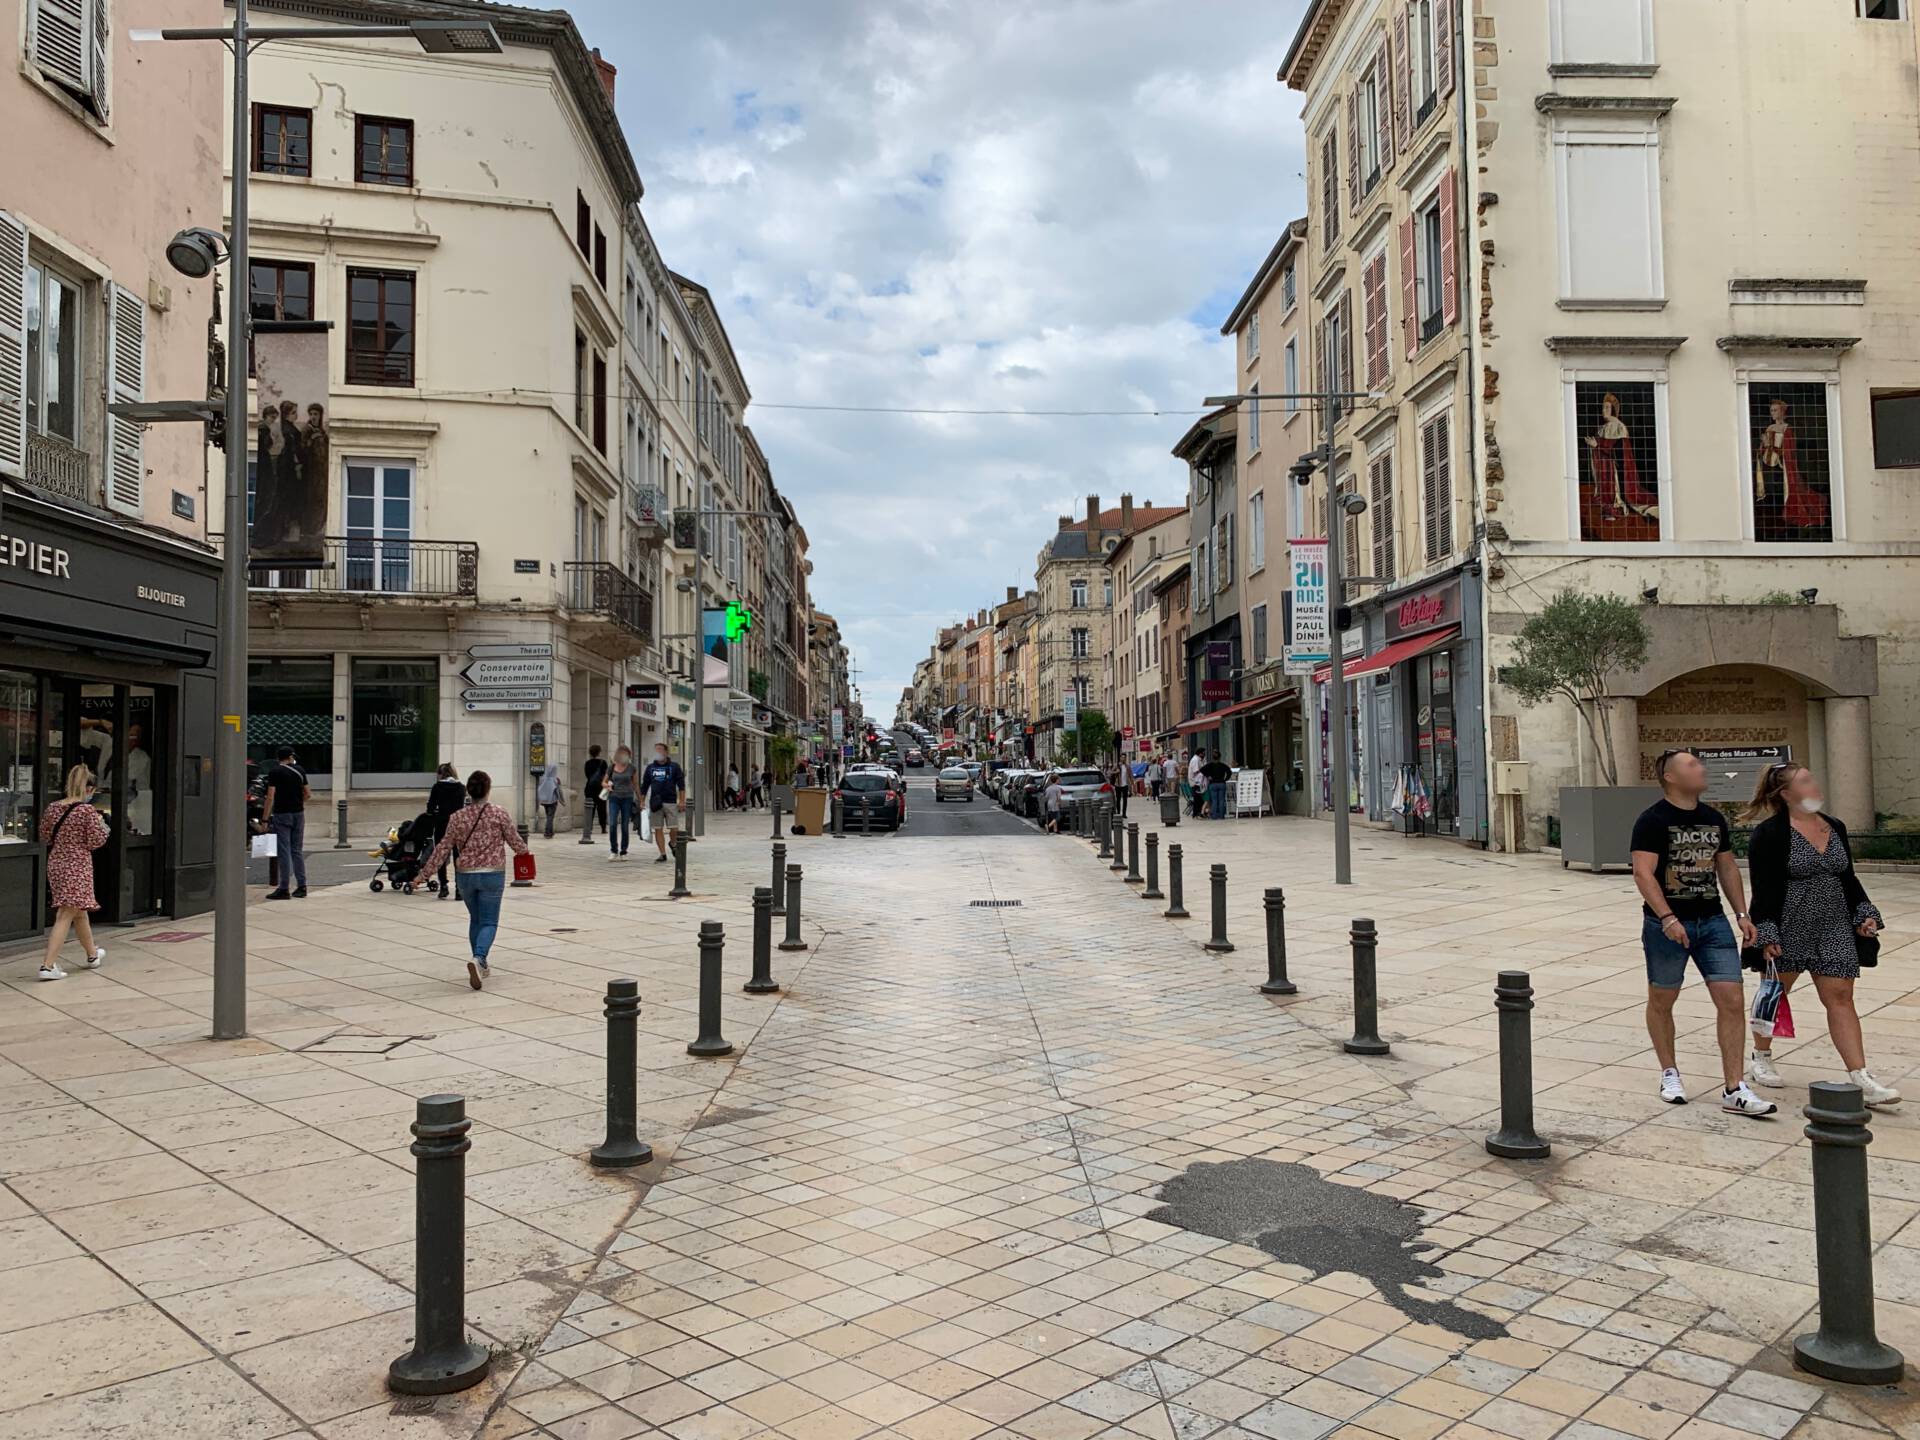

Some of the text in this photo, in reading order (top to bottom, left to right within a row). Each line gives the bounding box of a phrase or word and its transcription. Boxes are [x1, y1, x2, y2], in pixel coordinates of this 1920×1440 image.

[1296, 562, 1324, 587] 20
[137, 585, 186, 607] BIJOUTIER
[1296, 604, 1324, 613] MUSÉE
[1296, 622, 1325, 630] PAUL
[480, 663, 545, 672] Conservatoire
[480, 673, 549, 682] Intercommunal
[506, 690, 537, 698] Tourisme
[1204, 689, 1231, 697] VOISIN
[1699, 750, 1718, 758] Place
